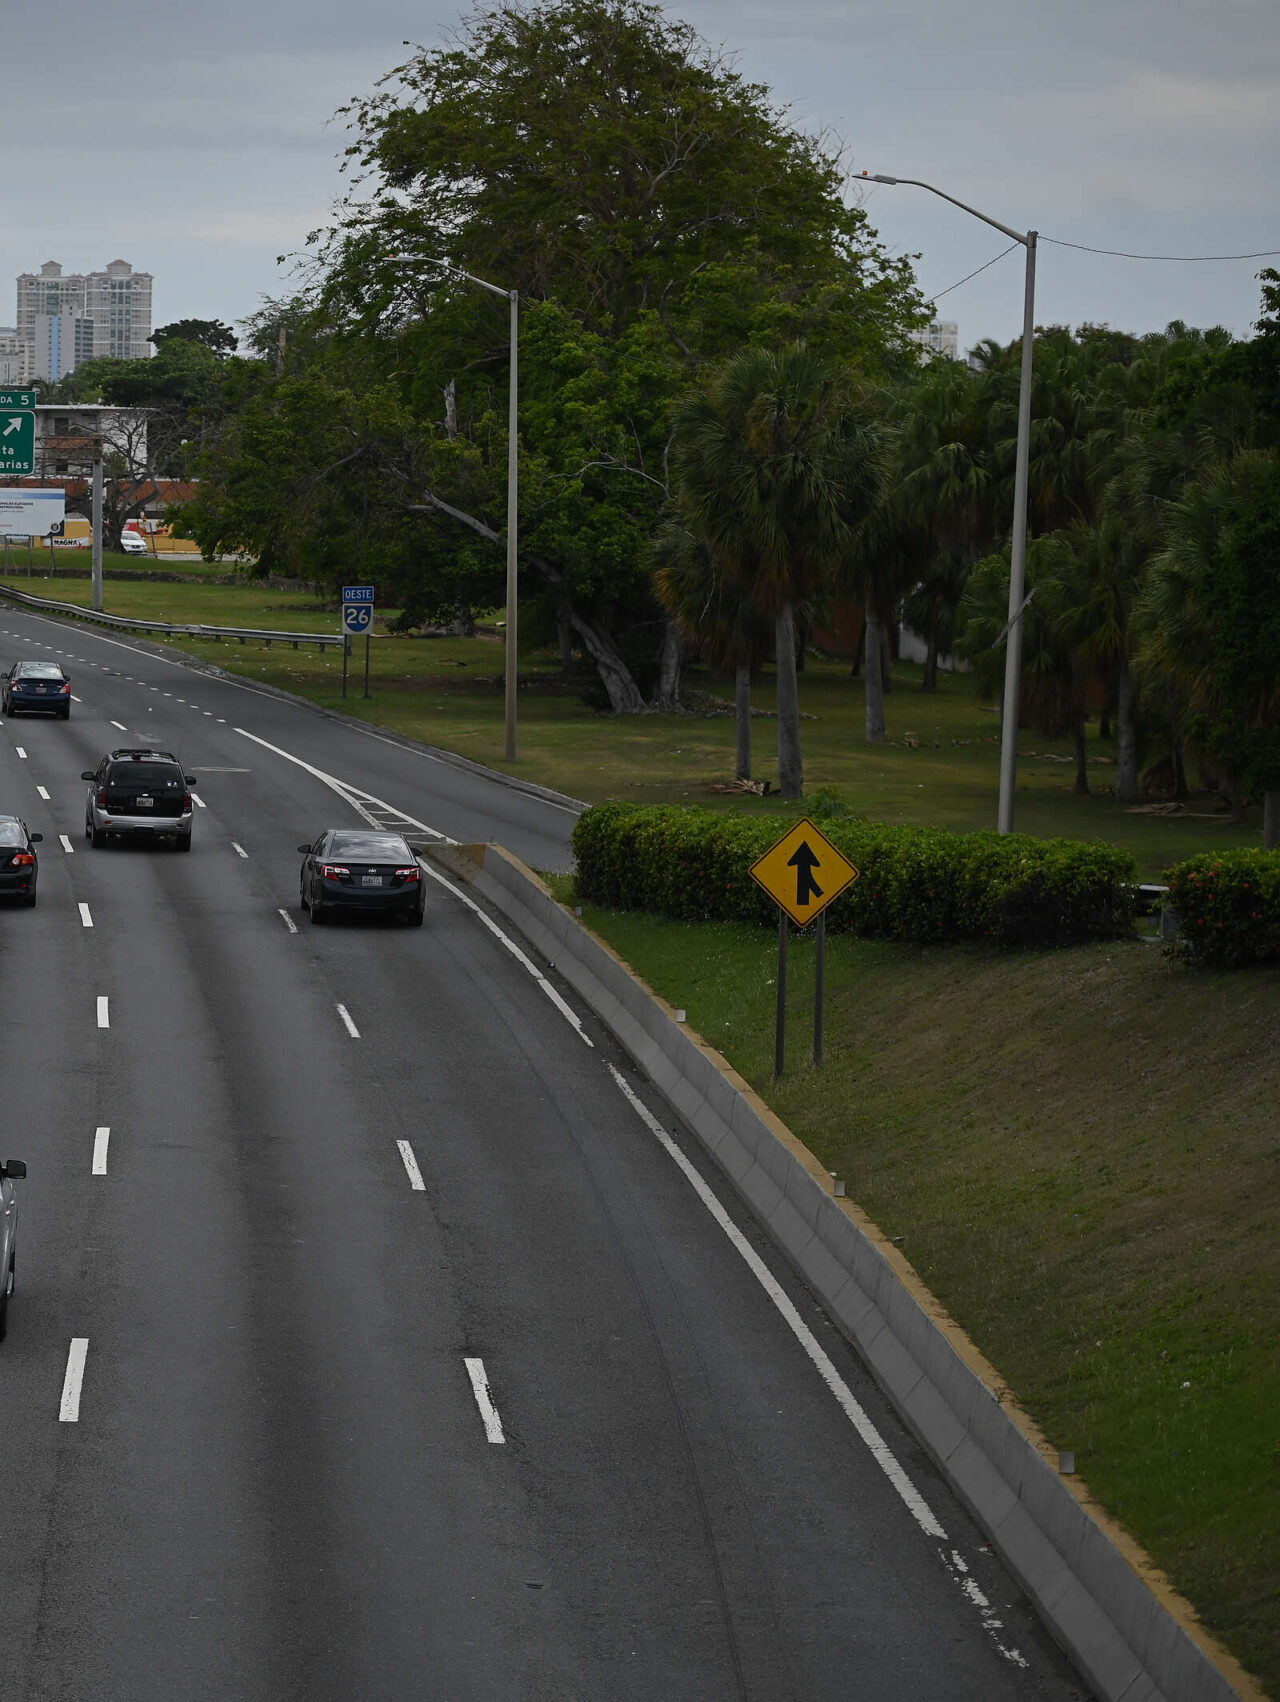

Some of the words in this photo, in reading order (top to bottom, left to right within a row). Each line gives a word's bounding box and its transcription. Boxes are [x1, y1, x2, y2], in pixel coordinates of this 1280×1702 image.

[21, 395, 29, 405] 5
[345, 589, 372, 599] OESTE
[347, 608, 368, 624] 26
